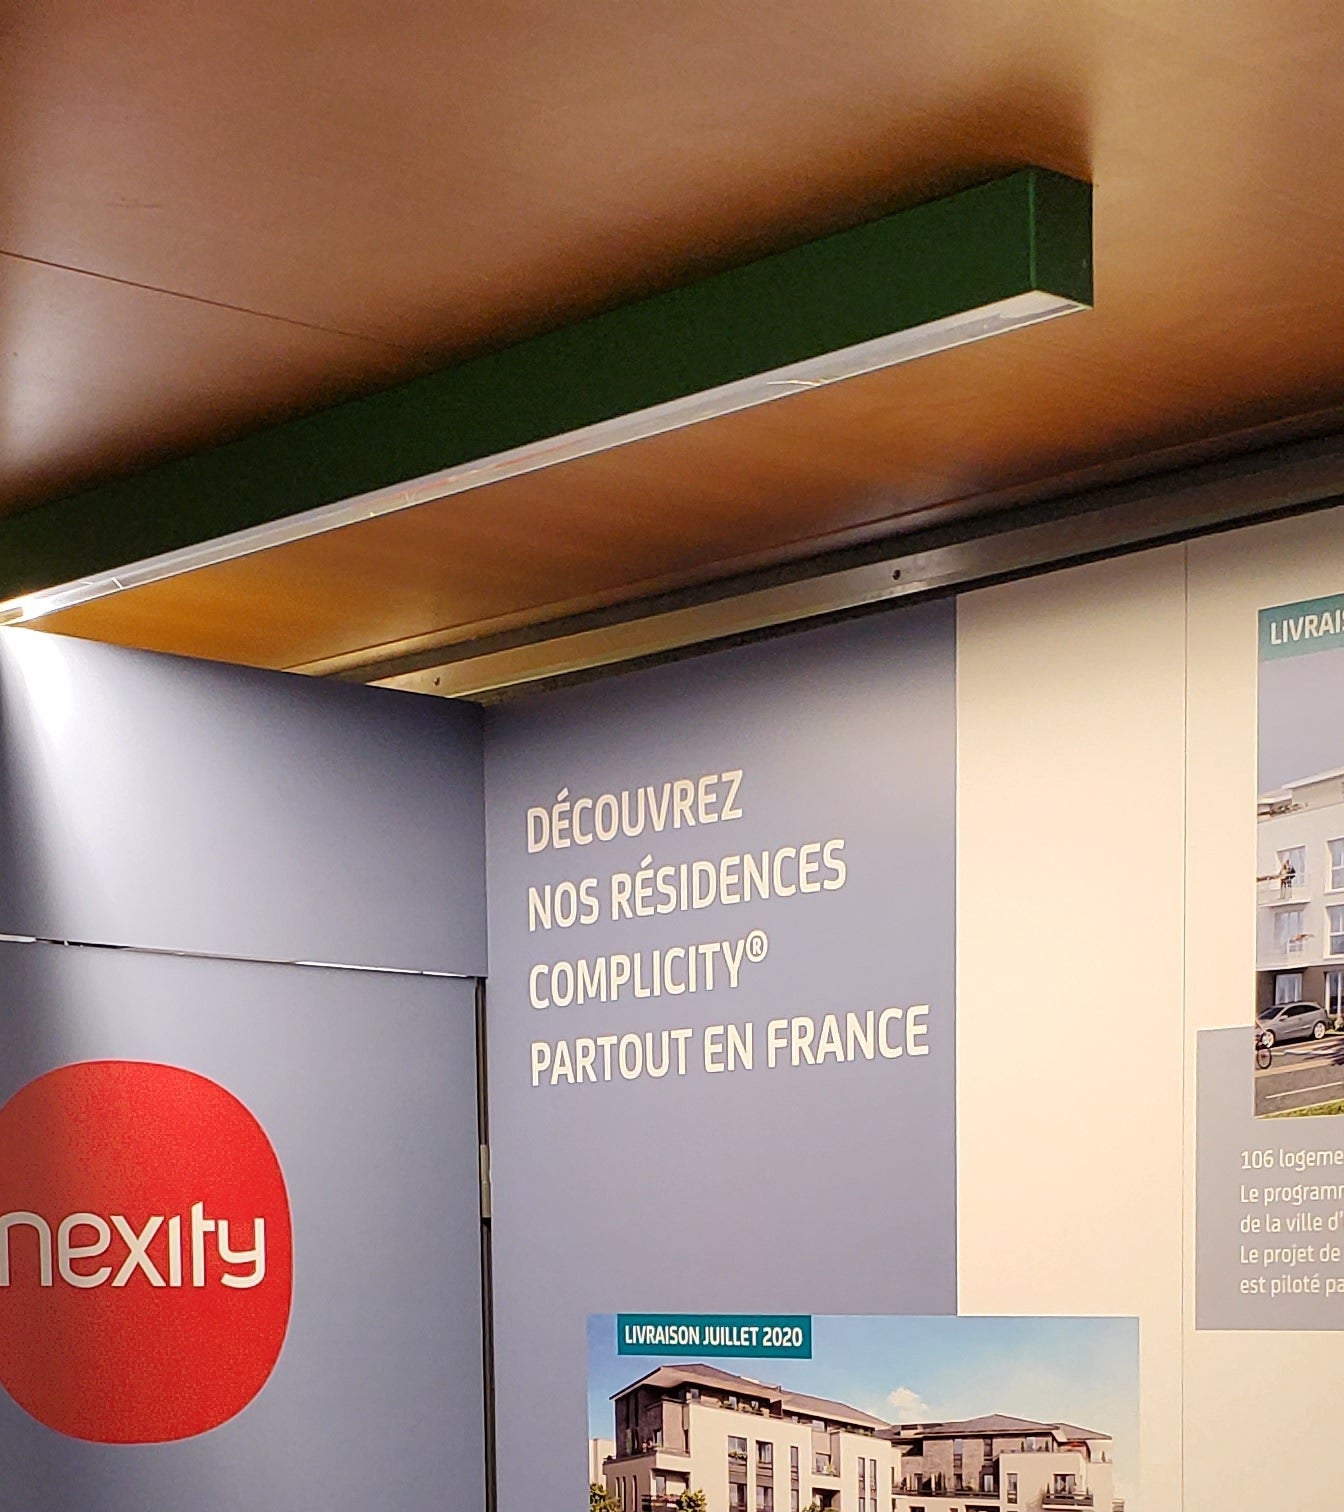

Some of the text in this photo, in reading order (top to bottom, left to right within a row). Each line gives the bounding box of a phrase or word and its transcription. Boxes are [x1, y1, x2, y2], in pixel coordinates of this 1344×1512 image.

[527, 769, 744, 854] DÉCOUVREZ
[528, 839, 847, 932] NOS RÉSIDENCES
[531, 1004, 930, 1087] PARTOUT EN FRANCE
[1240, 1150, 1274, 1169] 106
[1240, 1185, 1259, 1203] Le
[1240, 1214, 1261, 1233] de
[1265, 1213, 1281, 1233] la
[1285, 1212, 1323, 1233] ville
[1240, 1245, 1259, 1264] Le
[1263, 1244, 1315, 1267] projet
[1319, 1244, 1341, 1262] de
[1240, 1276, 1266, 1294] est
[1270, 1273, 1320, 1297] piloté
[625, 1324, 803, 1348] LIVRAISON JUILLET 2020
